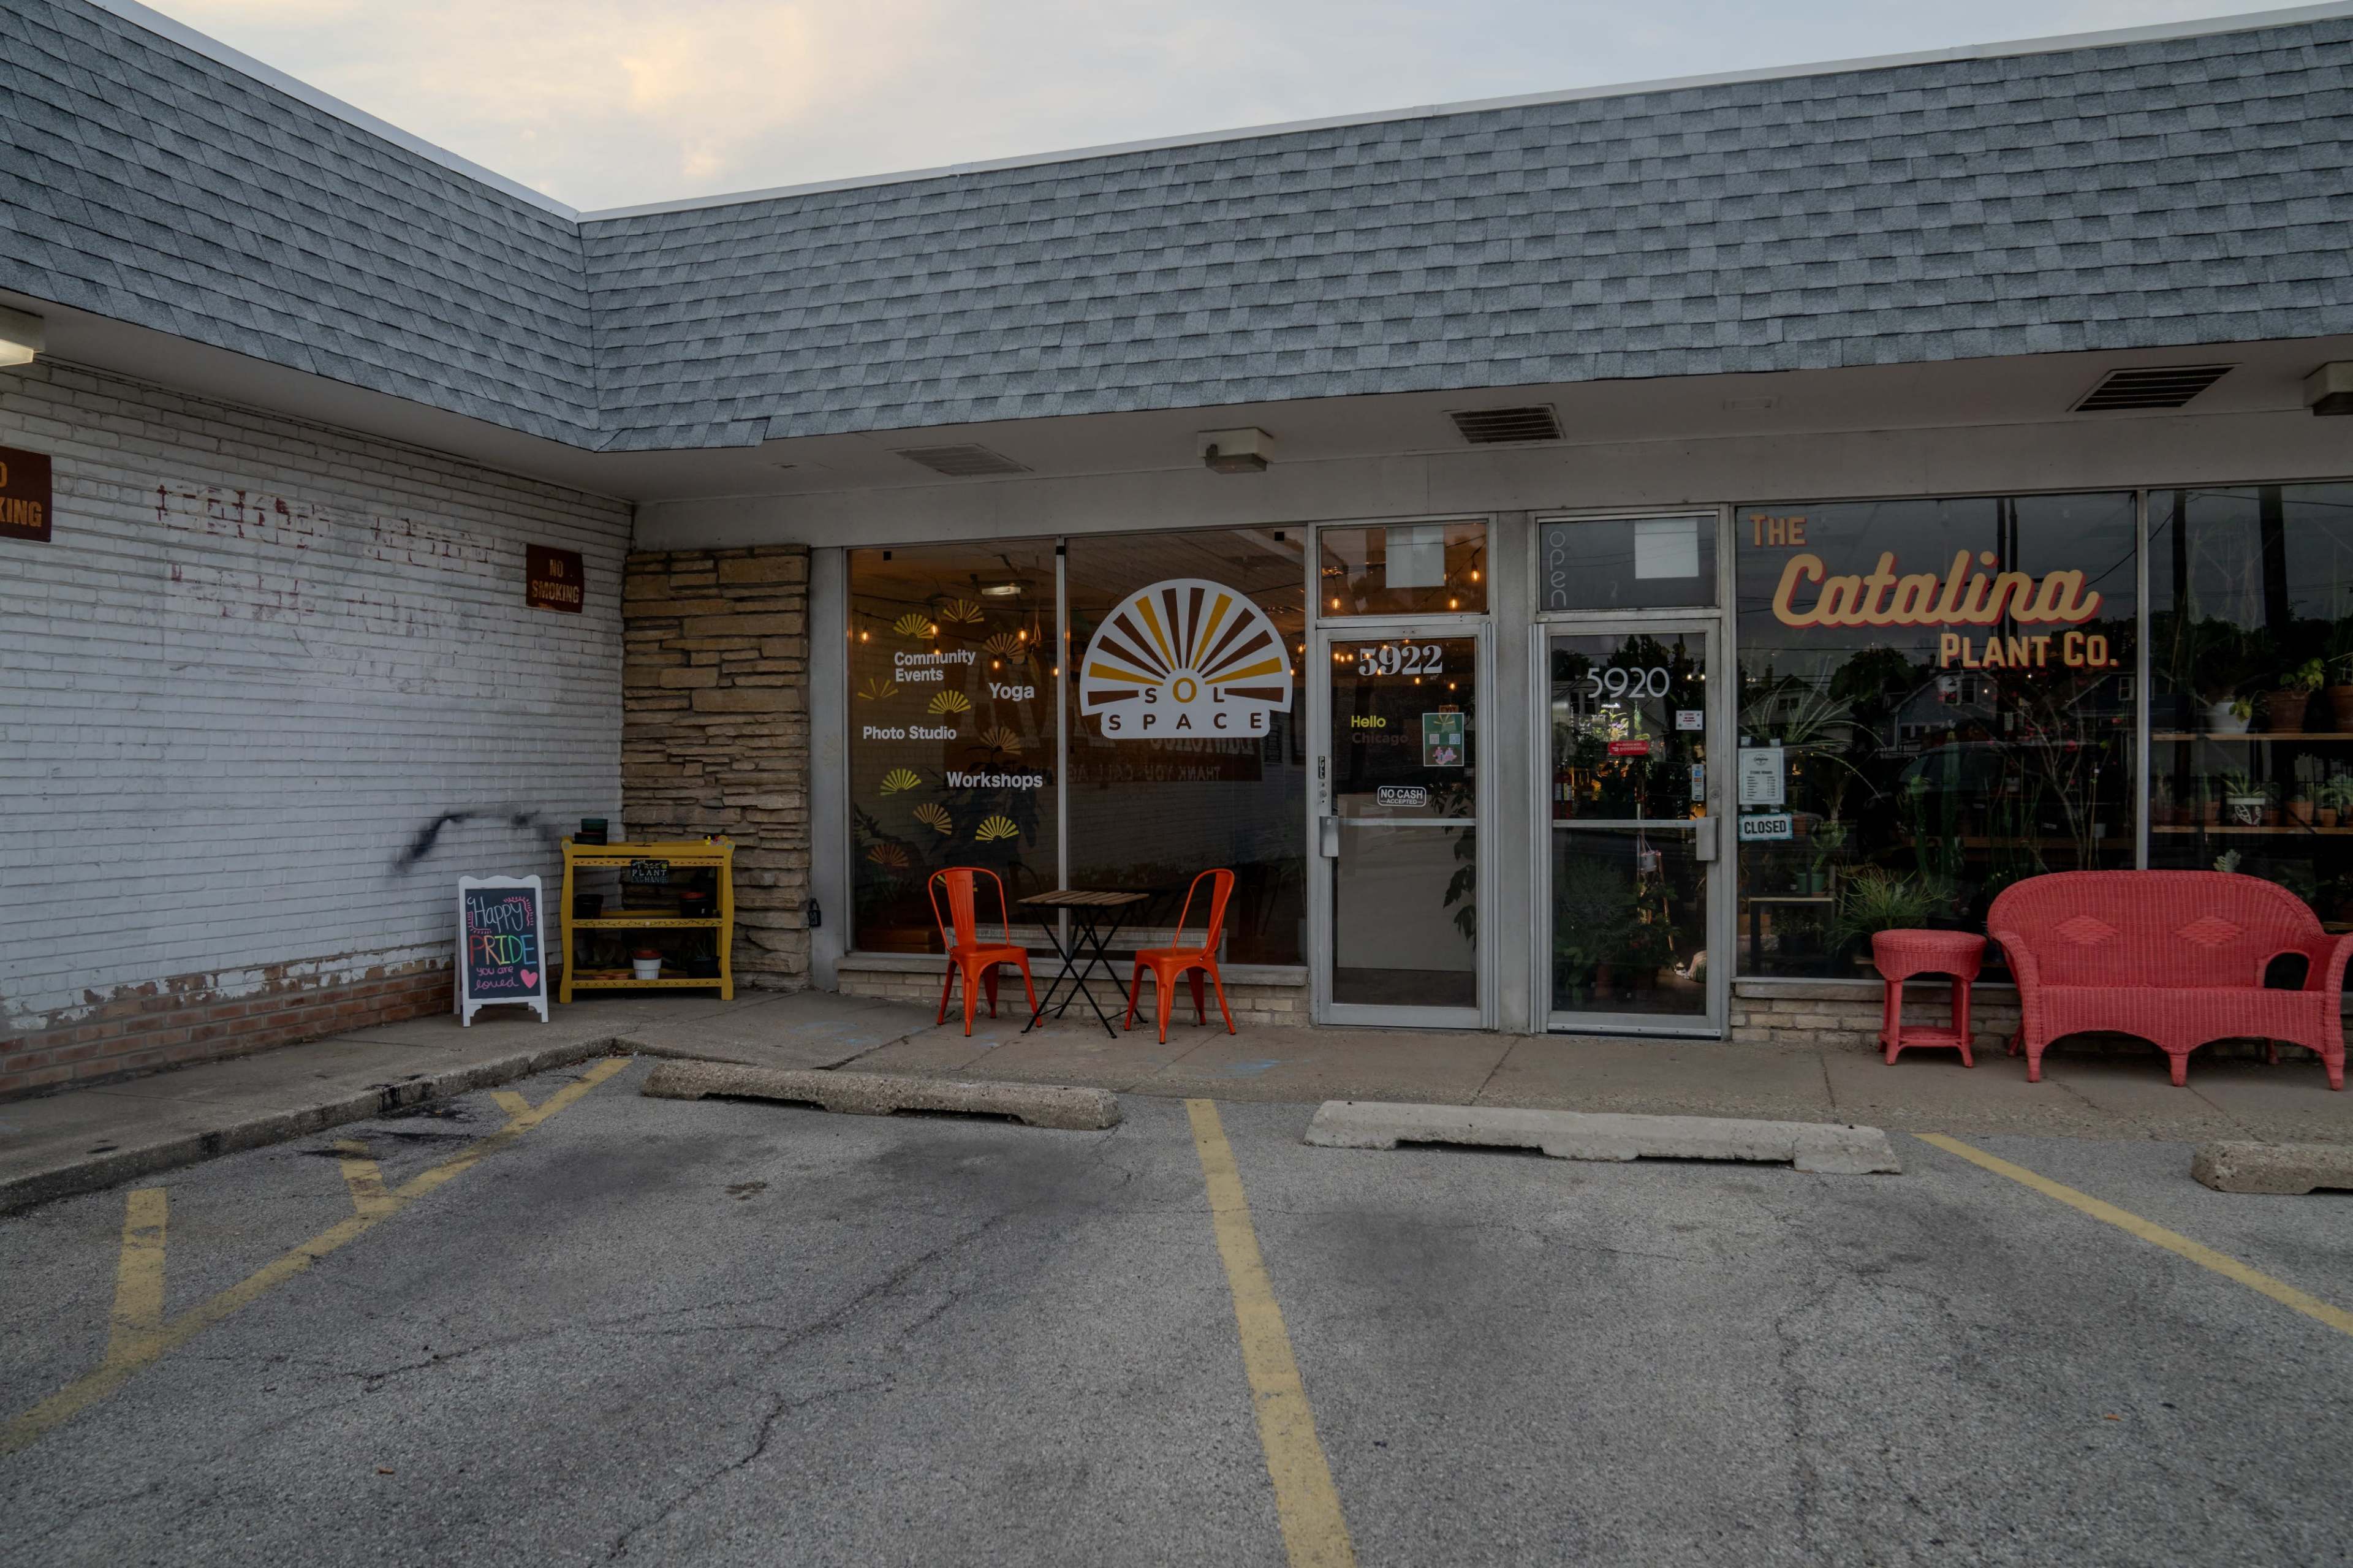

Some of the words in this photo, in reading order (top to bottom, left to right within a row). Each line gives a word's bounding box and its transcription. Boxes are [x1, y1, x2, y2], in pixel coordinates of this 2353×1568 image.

[1749, 514, 1807, 547] THE
[549, 559, 564, 578] NO
[1548, 530, 1567, 607] open
[531, 579, 579, 603] SMOKING
[1772, 549, 2102, 628] Catalina
[894, 649, 976, 666] Community
[1940, 632, 2052, 668] PLANT
[2063, 631, 2120, 667] CO.
[1358, 645, 1443, 676] 5922
[895, 667, 944, 682] Events
[1586, 667, 1670, 699] 5920
[988, 682, 1035, 702] Yoga
[1144, 676, 1226, 703] SOL
[1108, 712, 1262, 731] SPACE
[1351, 714, 1387, 728] Hello
[863, 725, 906, 740] Photo
[909, 725, 957, 740] Studio
[1352, 732, 1409, 746] Chicago
[946, 771, 1043, 790] Workshops
[1381, 789, 1395, 798] NO
[1397, 789, 1423, 800] CASH
[1744, 820, 1786, 834] CLOSED
[466, 896, 523, 934] Happy
[469, 934, 537, 966] PRIDE
[476, 966, 494, 977] you
[497, 965, 514, 974] are
[474, 977, 520, 991] loved
